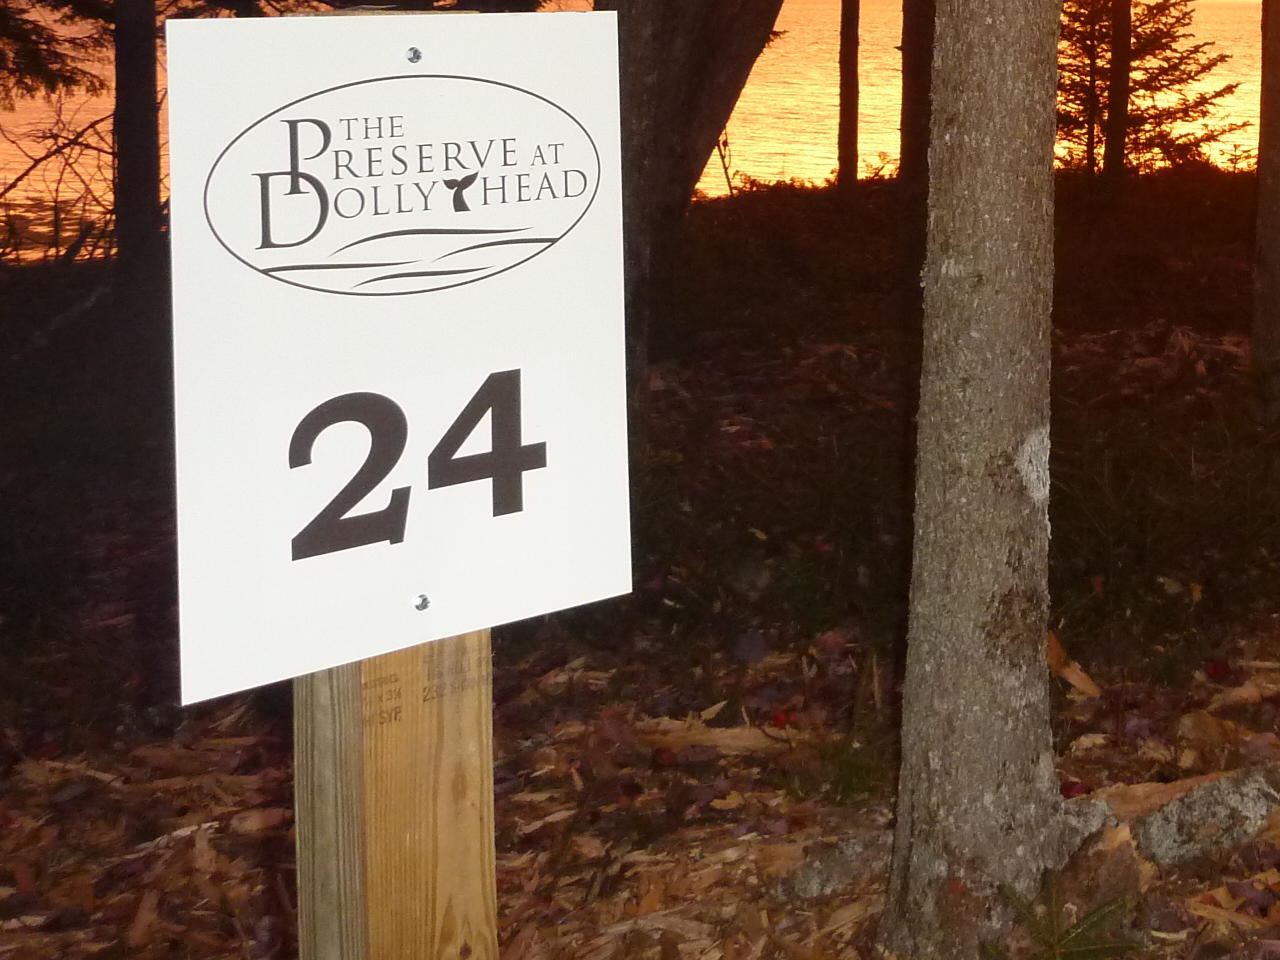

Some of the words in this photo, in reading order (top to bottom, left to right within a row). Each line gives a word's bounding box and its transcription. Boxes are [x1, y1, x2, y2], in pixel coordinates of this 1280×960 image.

[280, 118, 519, 196] PRESERVE
[530, 142, 565, 167] AT
[339, 115, 405, 141] THE
[251, 170, 439, 250] DOLLY
[481, 168, 588, 206] HEAD
[288, 368, 548, 562] 24
